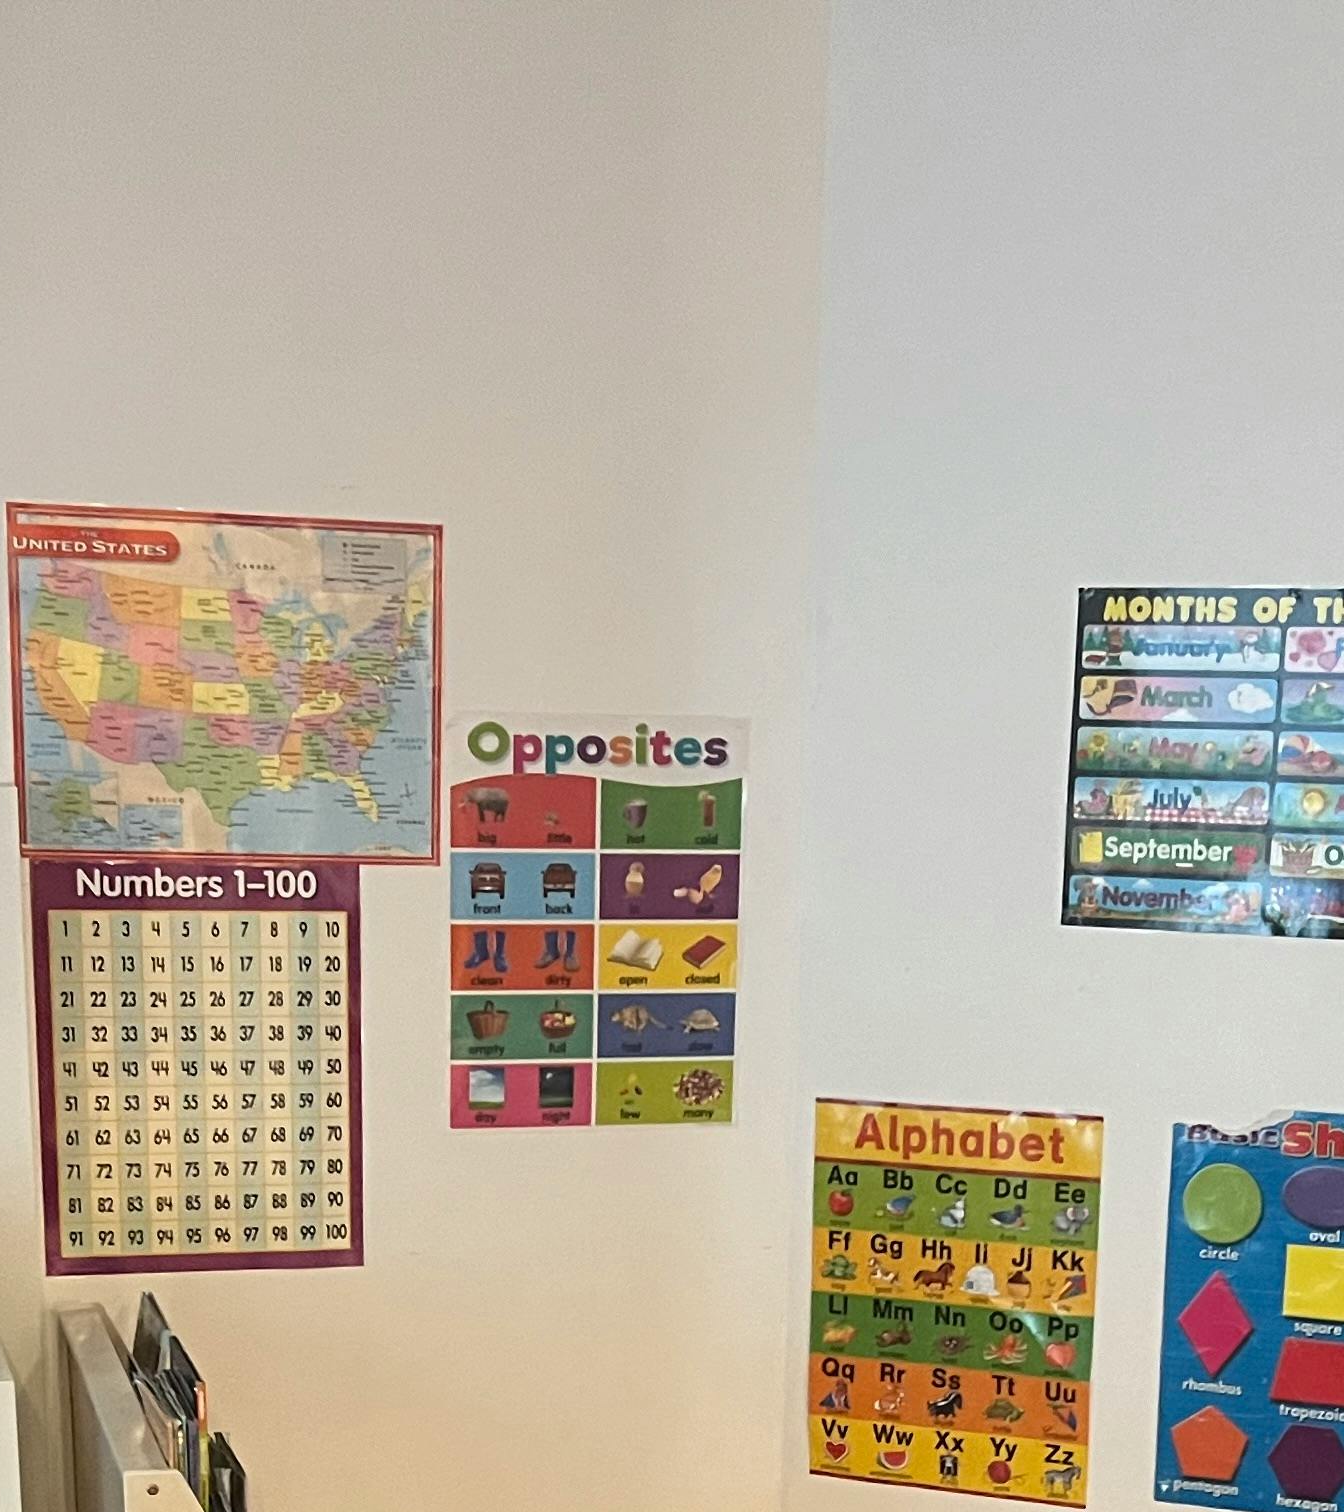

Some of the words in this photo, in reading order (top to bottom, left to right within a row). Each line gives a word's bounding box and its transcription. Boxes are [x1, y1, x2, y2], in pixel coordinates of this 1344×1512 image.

[12, 536, 87, 553] UNITED
[92, 541, 168, 556] STATES
[1103, 596, 1238, 623] MONTHS
[1252, 597, 1296, 623] OF
[1141, 685, 1213, 709] March
[467, 721, 729, 775] Opposites
[1149, 737, 1199, 762] May
[1147, 786, 1192, 815] July
[1105, 836, 1233, 864] September
[76, 868, 223, 898] Numbers
[473, 904, 501, 914] front
[545, 904, 573, 914] back
[619, 976, 648, 988] open
[685, 973, 720, 985] closed
[61, 1026, 76, 1043] 31
[91, 1025, 108, 1043] 32
[121, 1025, 138, 1042] 33
[150, 1026, 168, 1043] 34
[180, 1025, 197, 1042] 35
[210, 1025, 227, 1042] 36
[239, 1025, 256, 1042] 37
[268, 1024, 285, 1042] 38
[297, 1024, 313, 1041] 39
[324, 1025, 342, 1042] 40
[683, 1107, 714, 1120] many
[855, 1112, 1065, 1164] Alphabet
[827, 1165, 858, 1186] Aa
[883, 1169, 913, 1191] Bb
[935, 1174, 967, 1195] Cc
[994, 1178, 1027, 1200] Dd
[1054, 1182, 1086, 1204] Ee
[69, 1231, 84, 1247] 91
[98, 1230, 115, 1246] 92
[127, 1229, 144, 1246] 93
[156, 1229, 174, 1245] 94
[186, 1228, 202, 1244] 95
[214, 1227, 232, 1243] 96
[243, 1226, 259, 1242] 97
[272, 1225, 288, 1242] 98
[300, 1225, 317, 1240] 99
[325, 1223, 348, 1240] 100
[1309, 1231, 1340, 1243] oval
[828, 1230, 851, 1251] Ff
[870, 1234, 903, 1259] Gg
[921, 1239, 952, 1260] Hh
[975, 1244, 988, 1264] Ii
[1011, 1248, 1032, 1272] Jj
[1052, 1251, 1085, 1272] Kk
[1199, 1247, 1239, 1261] circle
[829, 1297, 848, 1316] Ll
[873, 1299, 913, 1321] Mm
[934, 1305, 966, 1327] Nn
[989, 1311, 1023, 1333] Oo
[1048, 1317, 1079, 1341] Pp
[1294, 1322, 1342, 1337] square
[822, 1357, 855, 1383] Qq
[880, 1363, 906, 1384] Rr
[931, 1368, 961, 1390] Ss
[992, 1374, 1015, 1396] Tt
[1045, 1382, 1076, 1403] Uu
[1182, 1378, 1242, 1396] rhombus
[821, 1418, 848, 1438] Vv
[873, 1424, 913, 1446] Ww
[935, 1431, 964, 1452] Xx
[990, 1437, 1018, 1461] Yy
[1045, 1444, 1074, 1465] Zz
[1277, 1494, 1338, 1512] hexagon
